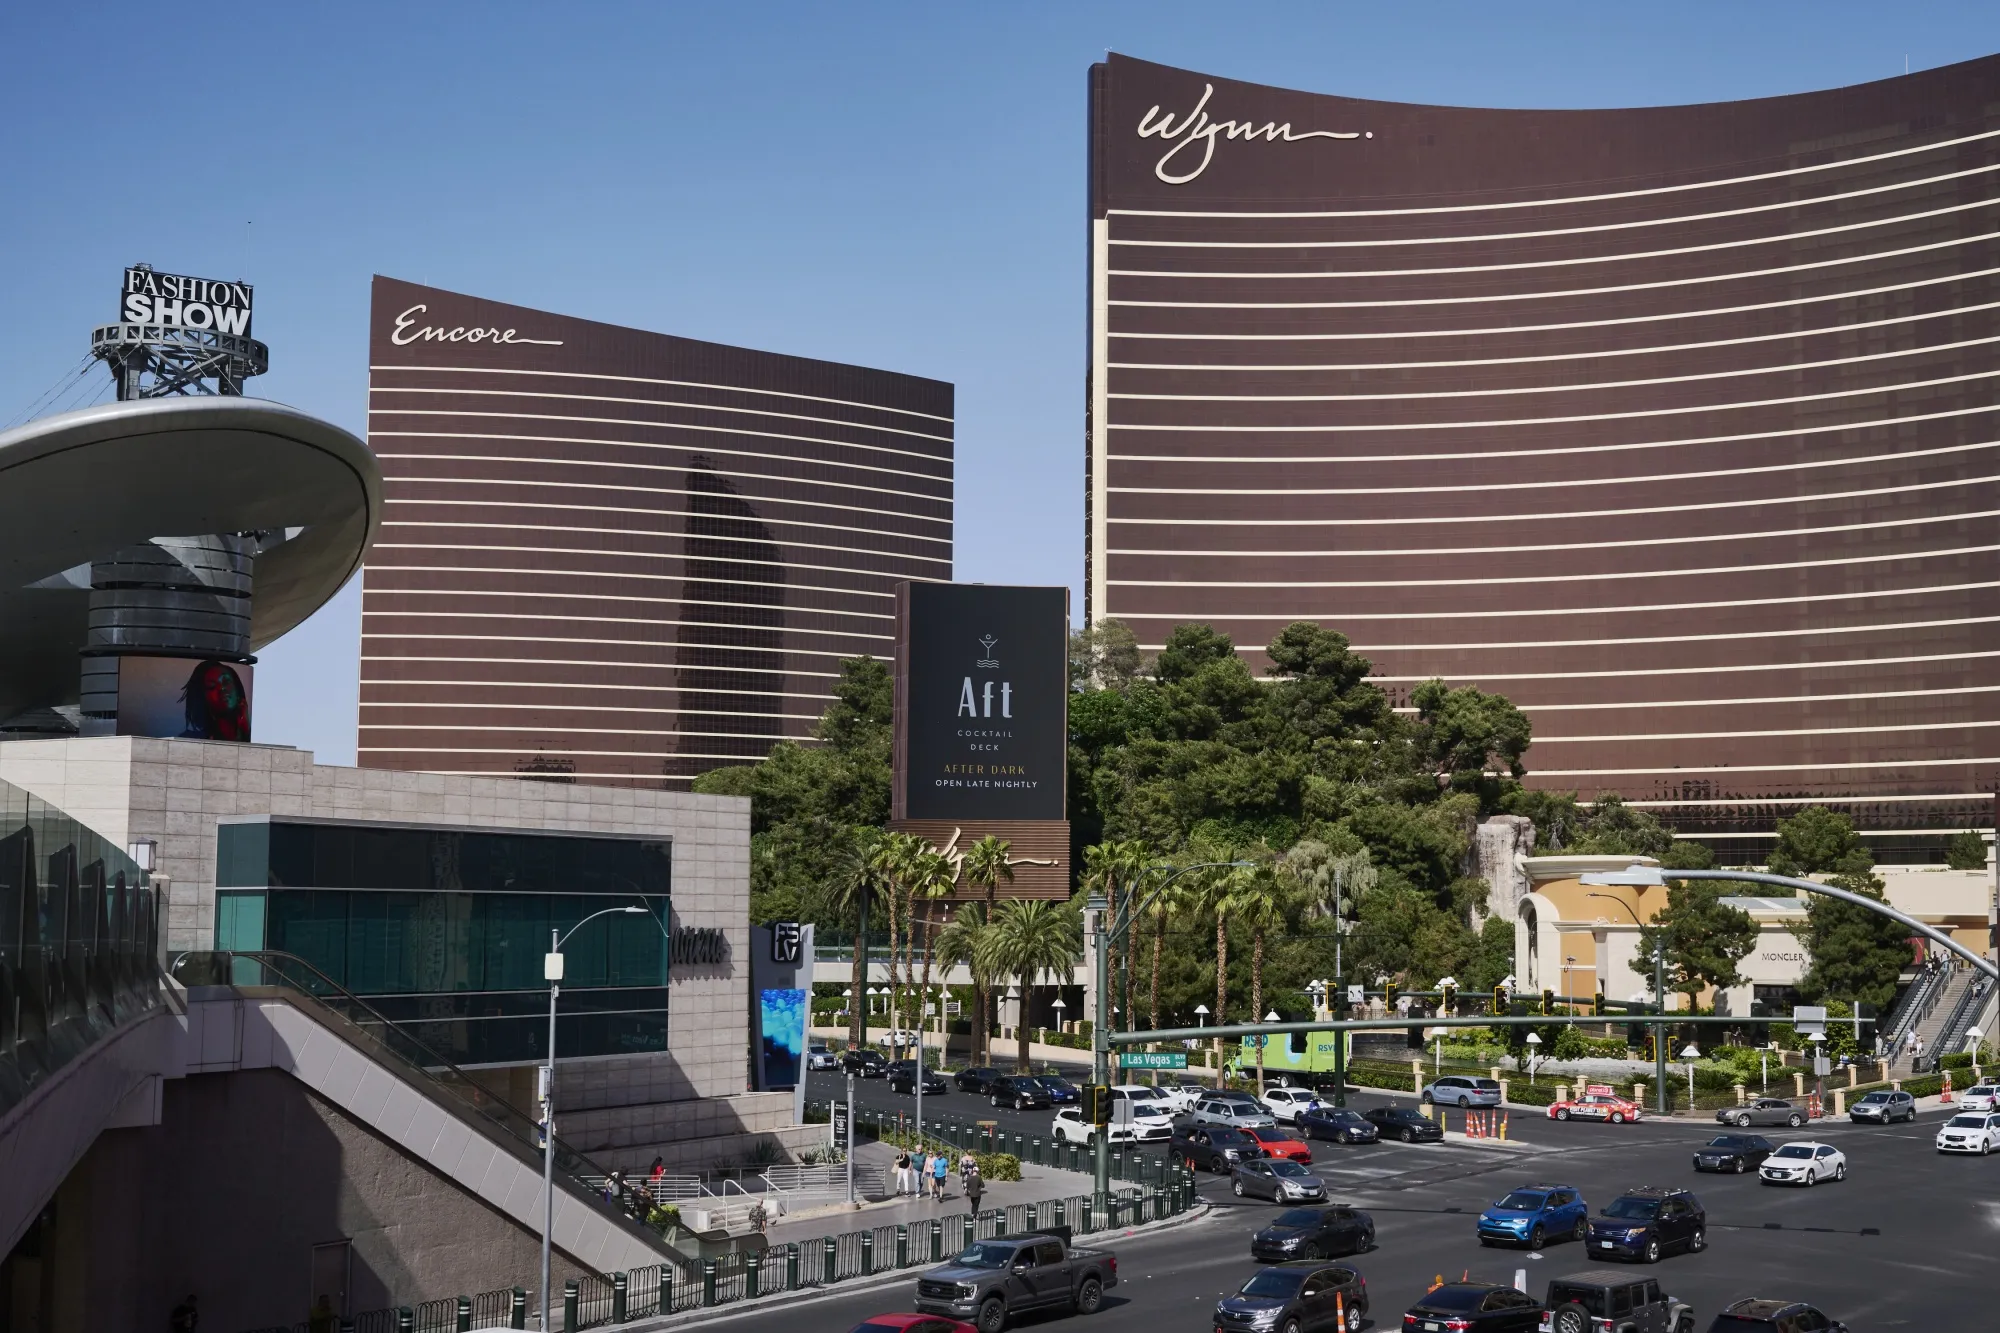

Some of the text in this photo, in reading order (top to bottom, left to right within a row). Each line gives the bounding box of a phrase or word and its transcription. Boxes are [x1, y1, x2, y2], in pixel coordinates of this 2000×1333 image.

[126, 269, 253, 309] FASHION
[124, 293, 251, 336] SHOW
[391, 304, 564, 346] Encore
[957, 676, 1013, 719] Aft
[957, 729, 1013, 738] COCKTAIL
[970, 743, 999, 751] DECK
[943, 764, 1025, 775] AFTER DARK
[935, 779, 1038, 789] OPEN LATE NIGHTLY
[1761, 953, 1805, 961] MONCLER
[1244, 1034, 1269, 1048] RSP
[1127, 1053, 1143, 1065] Las
[1144, 1053, 1171, 1068] Vegas
